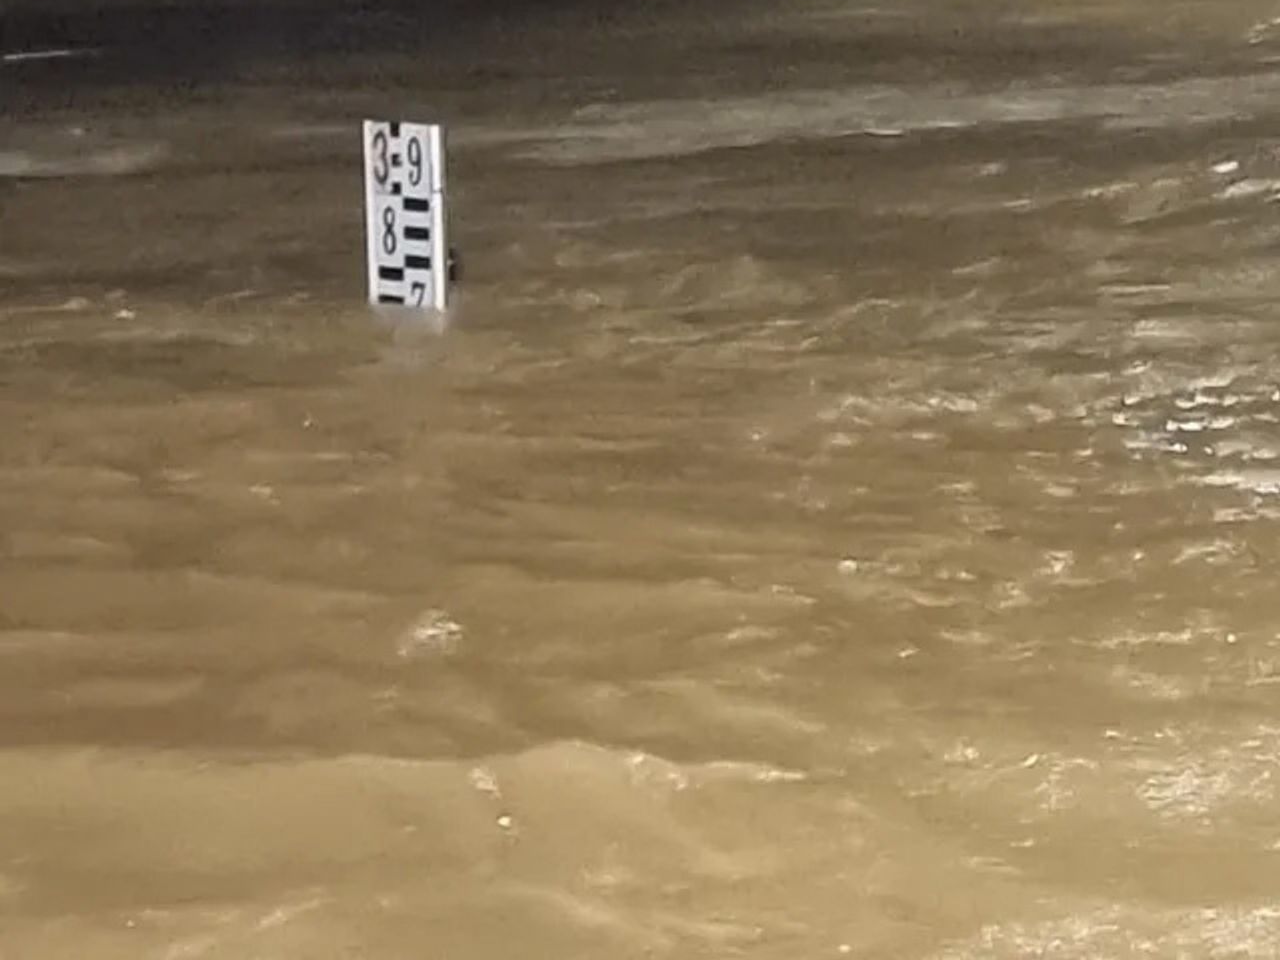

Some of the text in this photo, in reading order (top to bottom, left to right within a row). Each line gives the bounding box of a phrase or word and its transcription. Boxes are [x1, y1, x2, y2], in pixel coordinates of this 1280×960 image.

[372, 129, 422, 187] 3 9
[382, 206, 397, 255] 8
